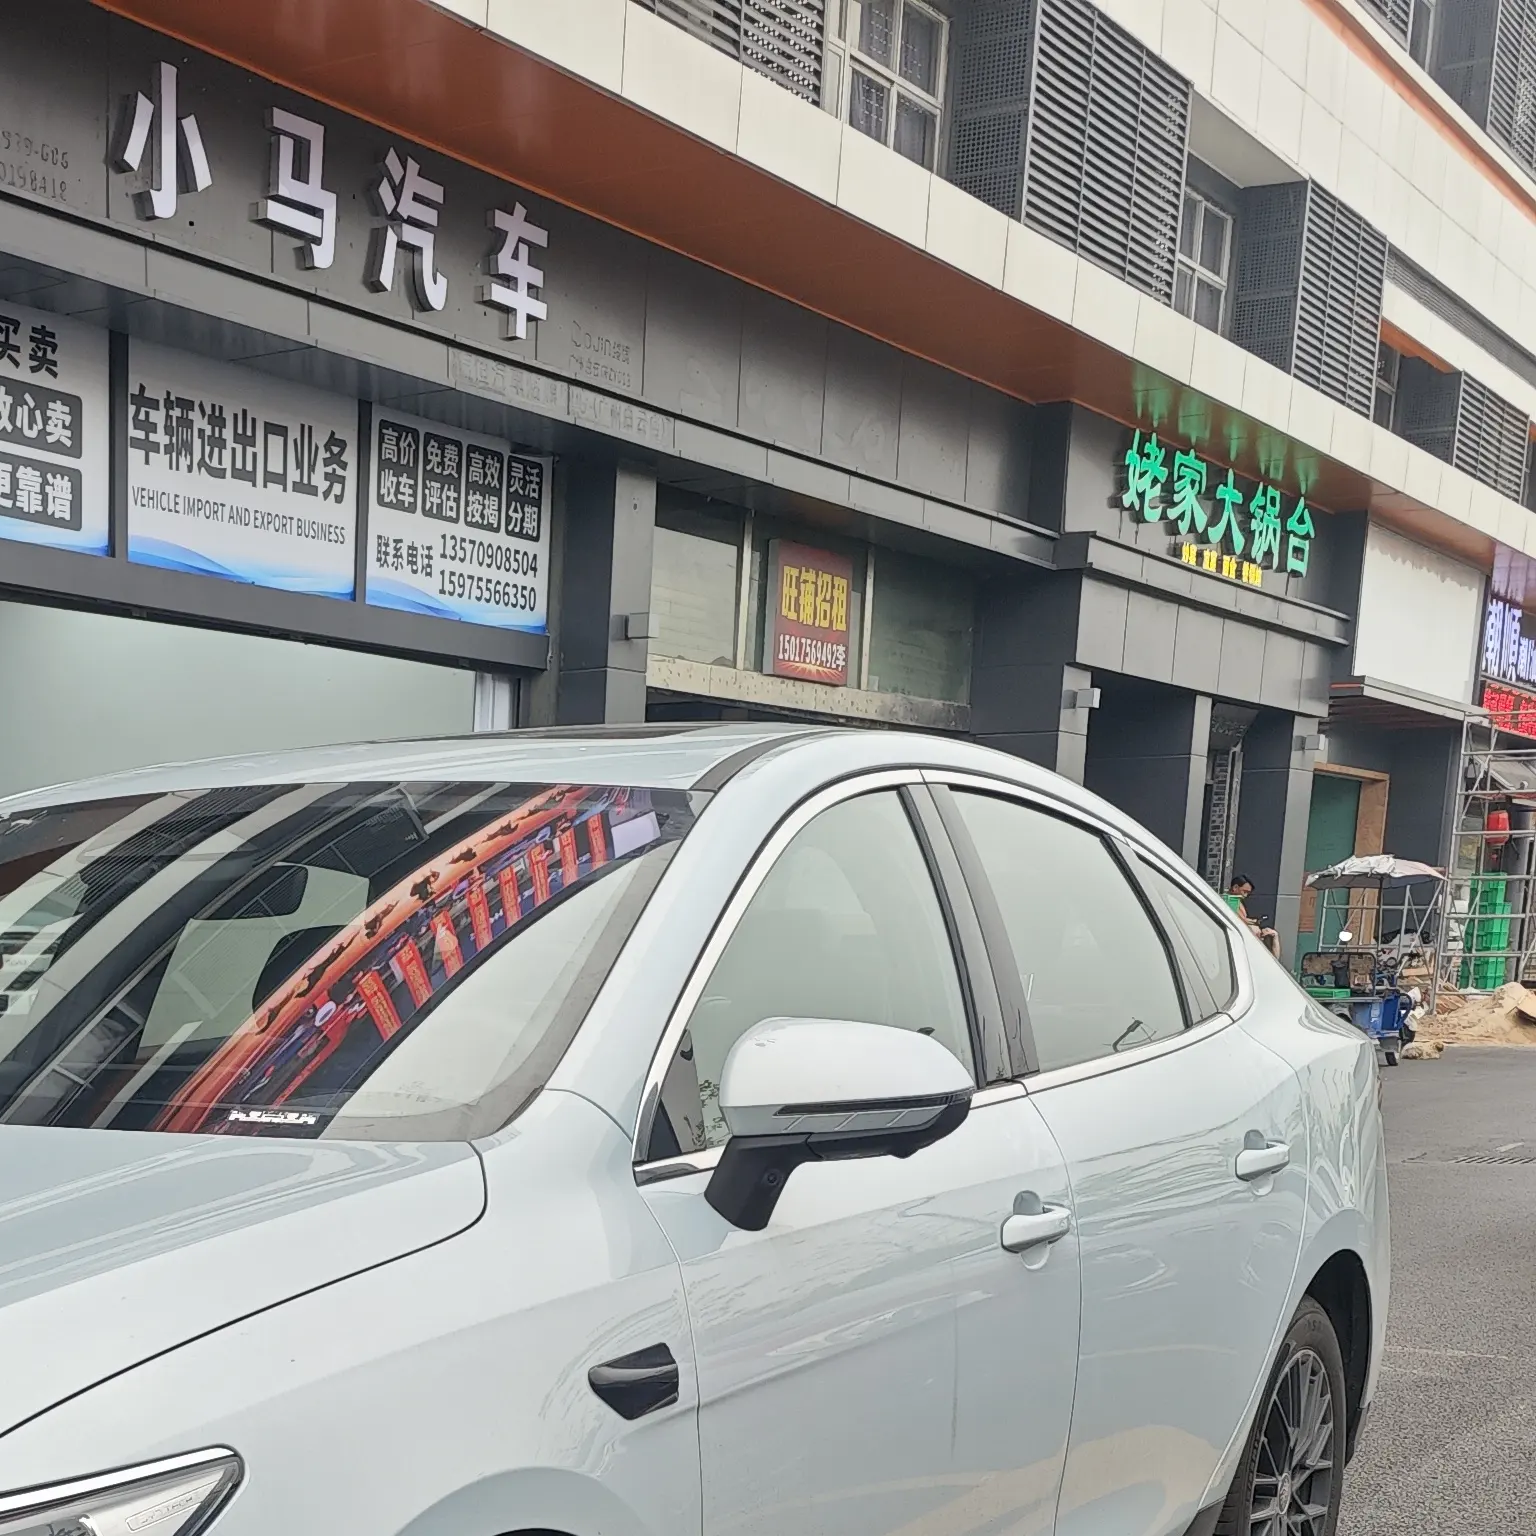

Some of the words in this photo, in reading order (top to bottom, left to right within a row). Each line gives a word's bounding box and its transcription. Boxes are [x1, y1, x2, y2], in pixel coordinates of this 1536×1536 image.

[114, 61, 549, 341] 小马汽车
[129, 382, 349, 505] 车辆进出口业务
[381, 427, 416, 468] 高价
[425, 438, 459, 478] 免费
[380, 468, 415, 509] 收车
[468, 451, 500, 490] 高效
[509, 460, 540, 500] 灵活
[132, 485, 180, 514] VEHICLE
[183, 495, 226, 522] IMPORT
[228, 505, 251, 527] AND
[253, 509, 294, 535] EXPORT
[296, 517, 346, 545] BUSINESS
[424, 479, 459, 520] 评估
[467, 489, 499, 529] 按揭
[508, 501, 538, 538] 分期
[1122, 428, 1315, 578] 姥家大锅台
[376, 534, 434, 579] 联系电话
[440, 533, 538, 579] 13570908504
[438, 569, 537, 612] 15975566350
[781, 565, 848, 632] 旺铺招租
